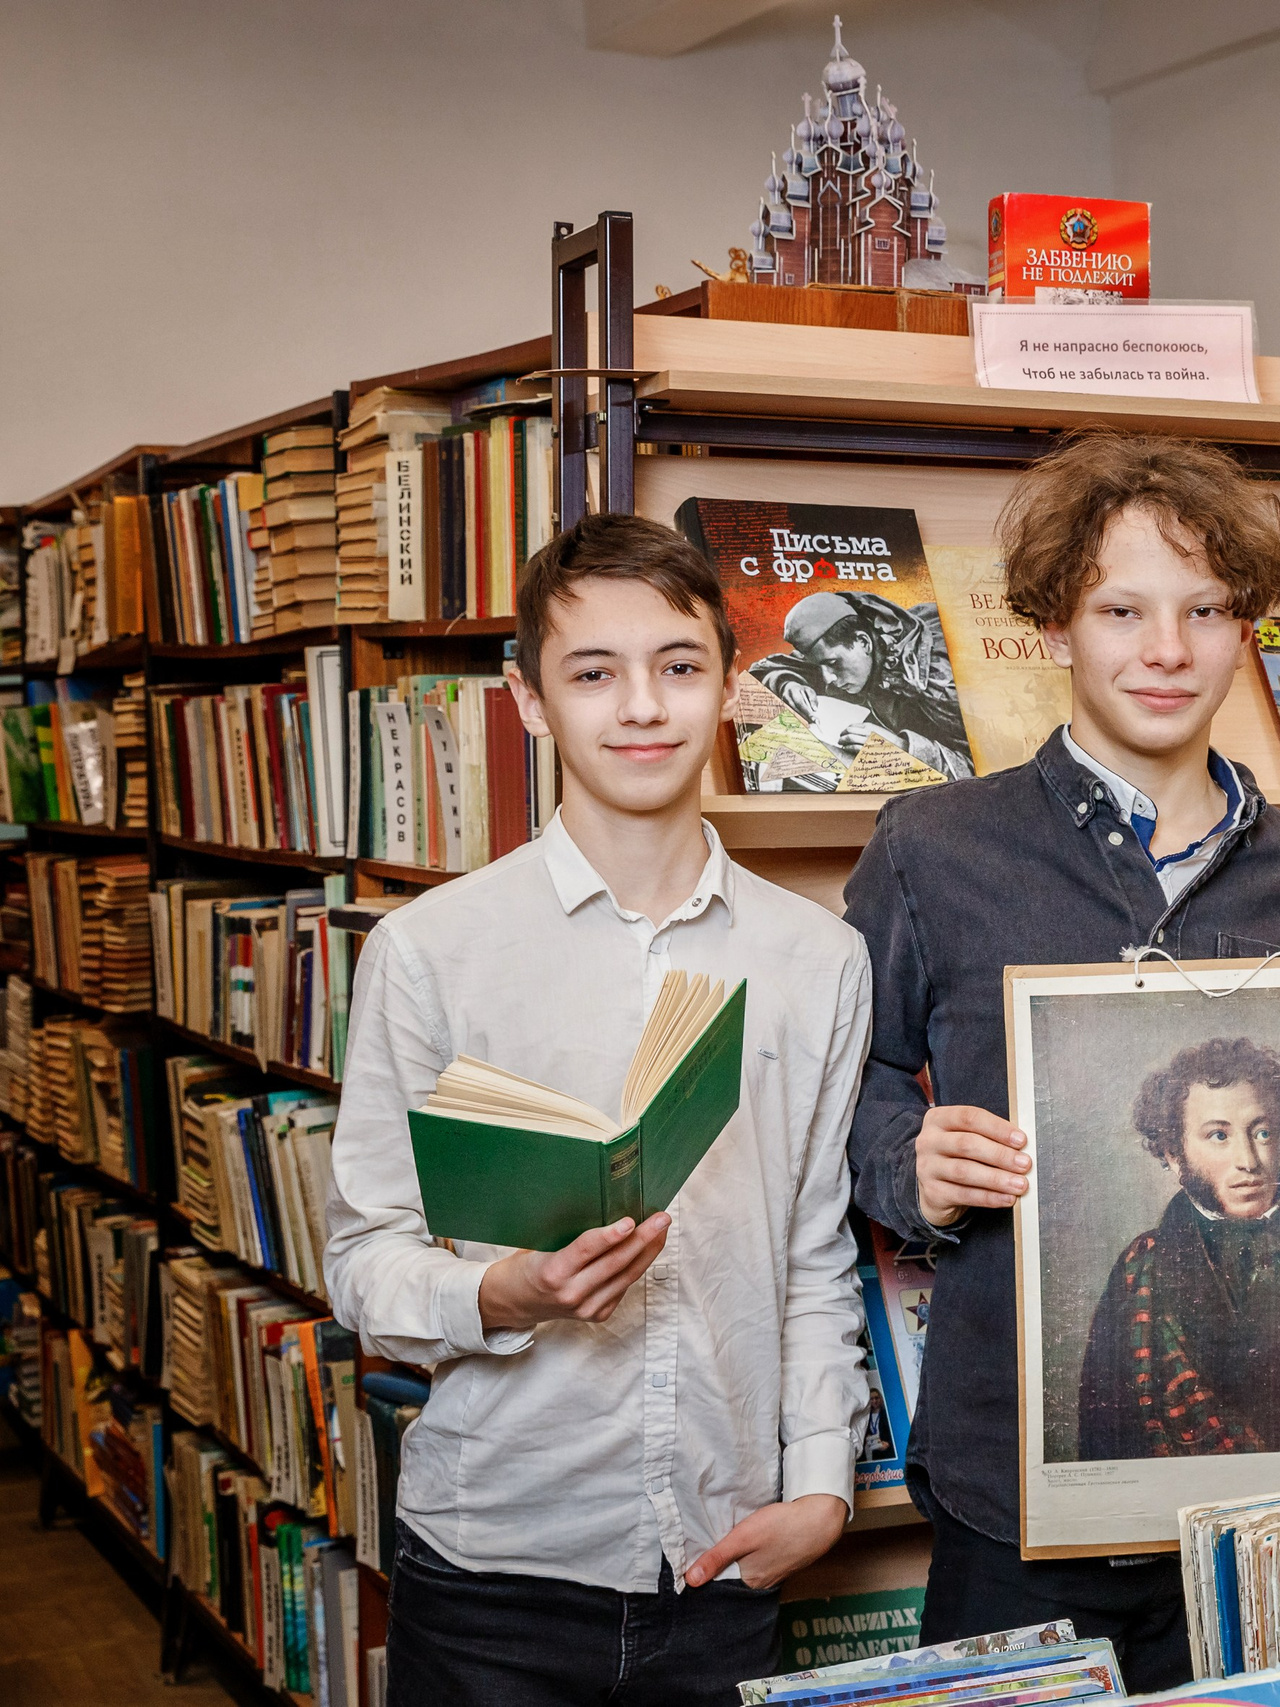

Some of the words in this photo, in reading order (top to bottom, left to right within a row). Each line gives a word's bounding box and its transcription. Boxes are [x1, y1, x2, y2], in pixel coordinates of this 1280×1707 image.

[1026, 248, 1132, 271] ЗАБВЕНИЮ
[1022, 266, 1043, 281] НЕ
[1050, 268, 1136, 287] ПОДЛЕЖИТ
[1019, 340, 1028, 352] Я
[1033, 342, 1049, 352] не
[1053, 342, 1119, 357] напрасно
[1122, 340, 1208, 356] беспокоюсь,
[1022, 367, 1056, 380] Чтоб
[1060, 370, 1076, 380] не
[1080, 368, 1144, 381] забылась
[1147, 370, 1161, 380] та
[1165, 368, 1210, 381] война.
[396, 459, 413, 586] БЕЛИНСКИЙ
[769, 528, 891, 556] Письма
[740, 556, 760, 576] с
[969, 593, 1012, 610] ВЕЛ
[975, 616, 1033, 628] ОТЕЧЕС
[980, 631, 1053, 660] ВОЙ
[386, 711, 406, 844] НЕКРАСОВ
[433, 717, 463, 840] ПУШКИН
[792, 1620, 808, 1638] О
[796, 1647, 812, 1666] О
